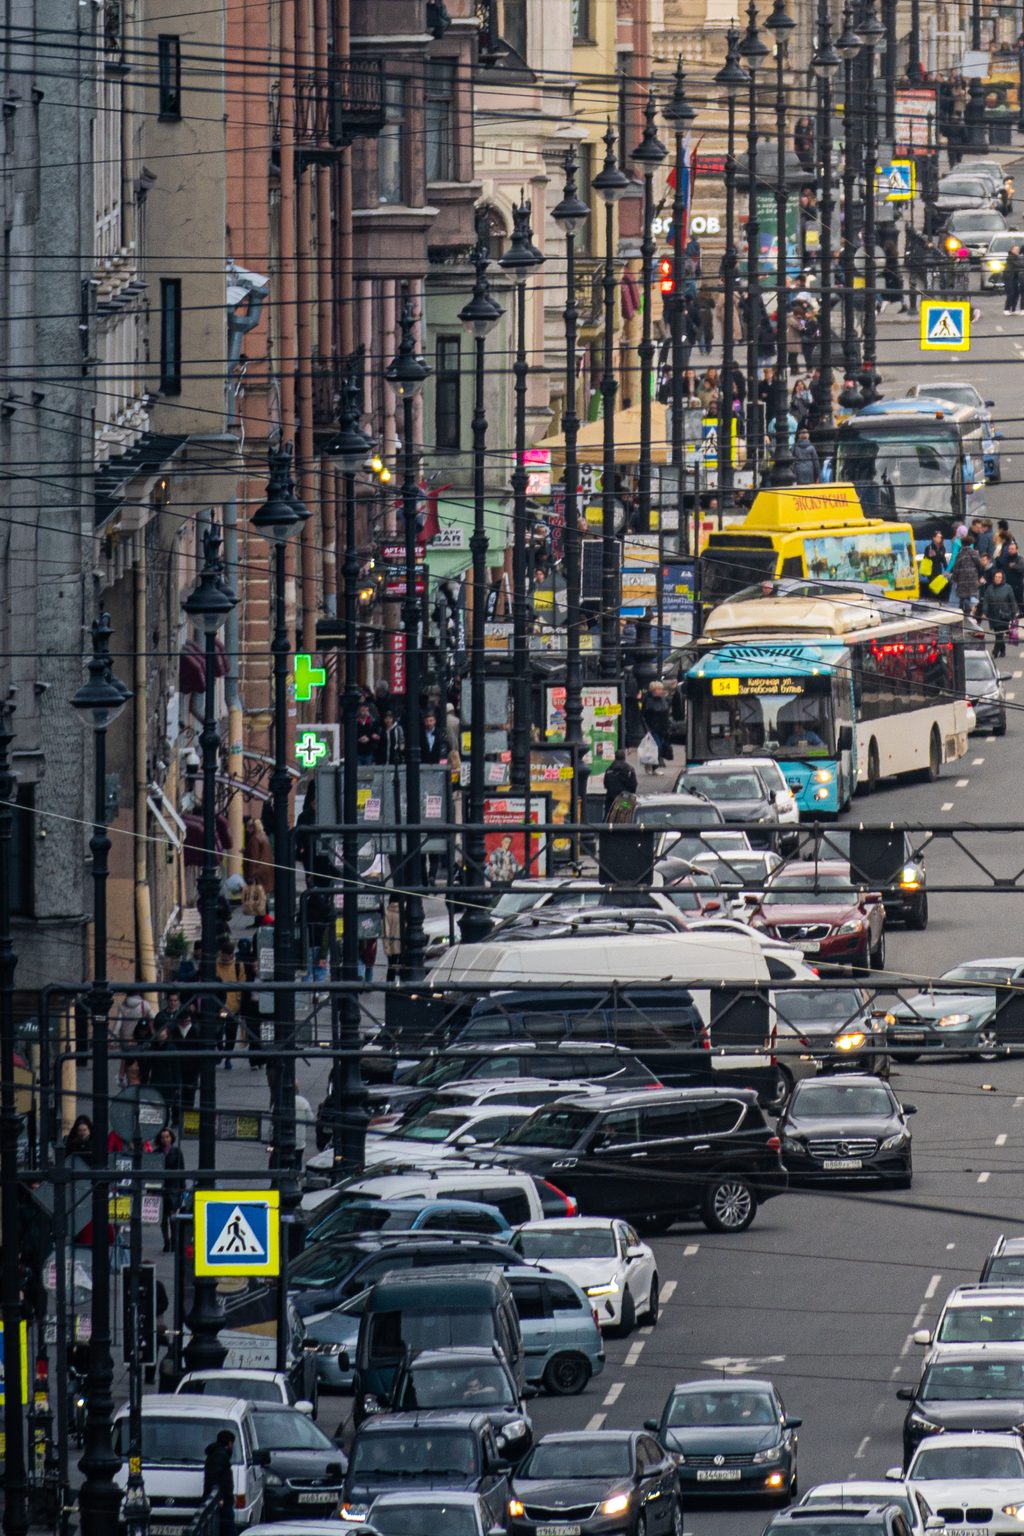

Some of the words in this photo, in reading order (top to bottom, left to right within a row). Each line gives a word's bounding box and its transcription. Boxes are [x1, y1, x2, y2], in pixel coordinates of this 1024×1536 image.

[793, 493, 848, 511] ЭКСКУРСИИ
[394, 635, 404, 693] ПРОДУКТЫ
[719, 682, 731, 691] 54
[581, 696, 612, 707] ЕНА
